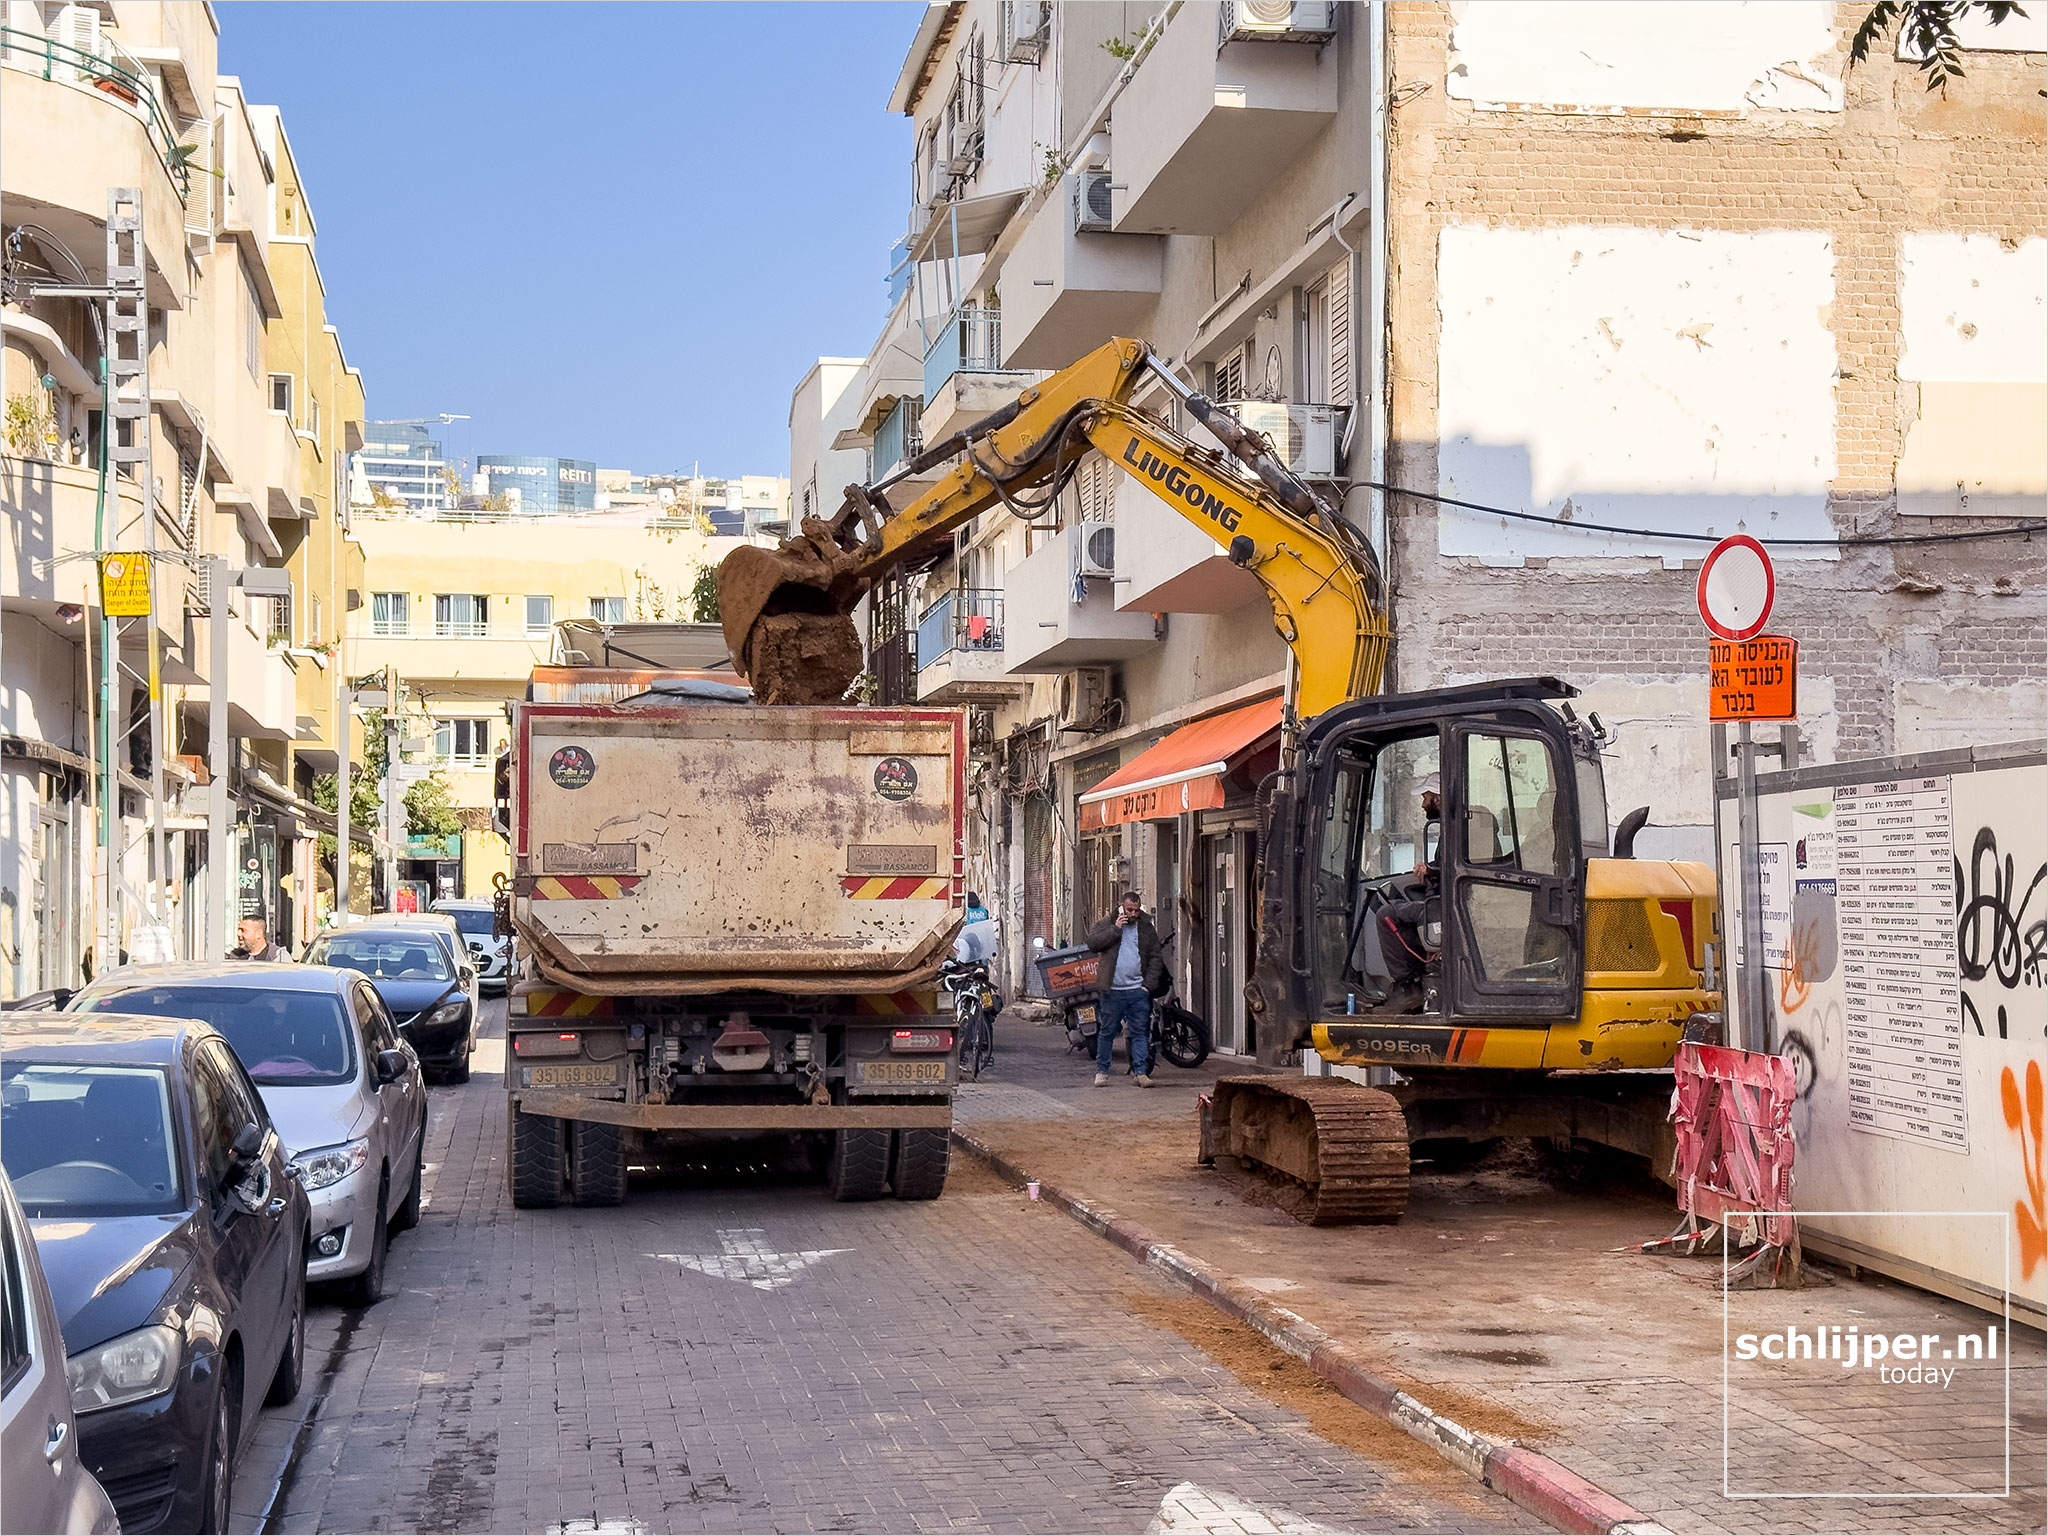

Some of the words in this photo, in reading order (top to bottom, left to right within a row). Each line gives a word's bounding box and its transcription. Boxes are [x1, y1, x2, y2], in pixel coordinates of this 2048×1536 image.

[492, 465, 515, 475] ישיר
[518, 465, 547, 476] ביטוח
[1123, 437, 1243, 533] LIUGONG
[106, 599, 124, 607] Danger
[1738, 642, 1790, 661] הכניסה
[1736, 663, 1783, 685] לעובדי
[1722, 690, 1755, 712] בלבד
[1923, 779, 1935, 788] תחום
[581, 862, 628, 870] BASSAMCO
